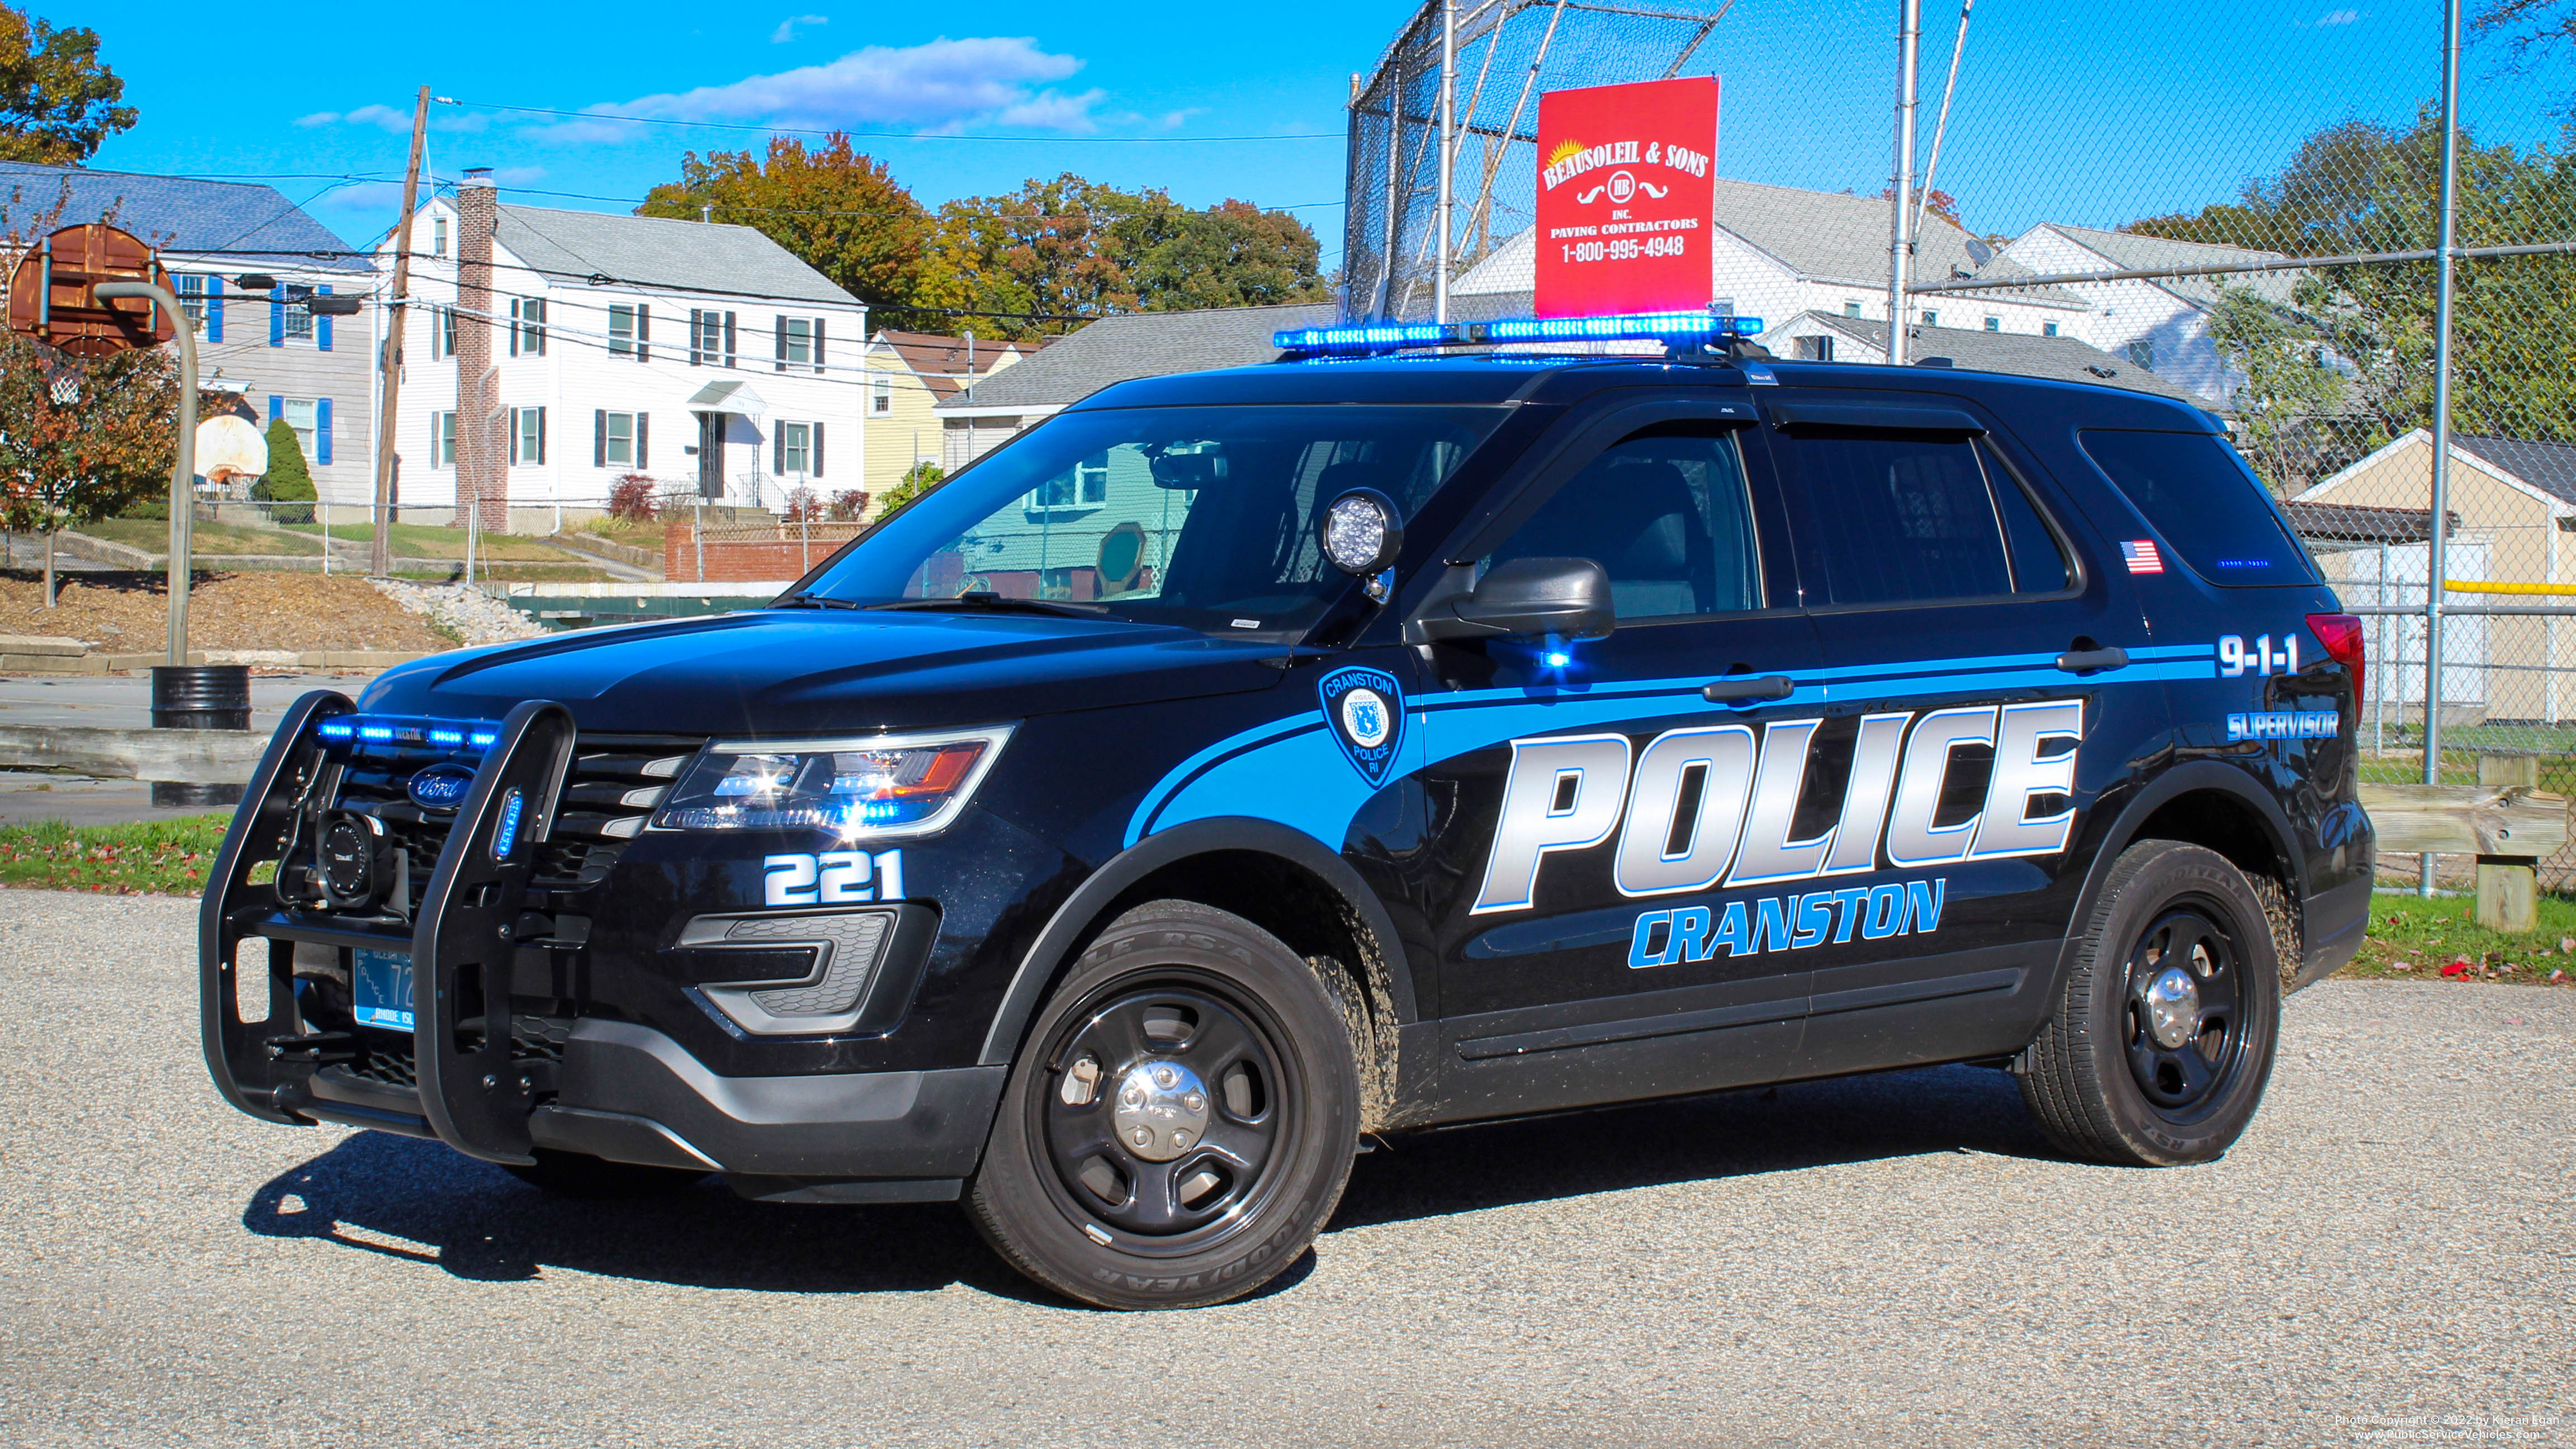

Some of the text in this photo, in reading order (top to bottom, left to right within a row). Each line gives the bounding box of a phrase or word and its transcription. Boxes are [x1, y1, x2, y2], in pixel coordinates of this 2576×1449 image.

[1542, 141, 1709, 191] BEAUSOLEIL & SONS
[1613, 178, 1630, 196] HB
[1612, 209, 1632, 220] INC.
[1550, 218, 1698, 239] PAVING CONTRACTORS
[1561, 235, 1684, 263] 1-800-995-4948
[2218, 633, 2299, 678] 9-1-1
[1325, 673, 1392, 698] CRANSTON
[2227, 711, 2339, 741] SUPERVISOR
[1353, 743, 1390, 761] POLICE
[1369, 762, 1379, 773] RI
[417, 779, 461, 798] Ford
[1469, 699, 2083, 916] POLICE
[763, 847, 907, 907] 221
[1627, 878, 1947, 970] CRANSTON
[357, 959, 384, 1004] POLICE
[375, 1007, 414, 1025] RHODE ISL
